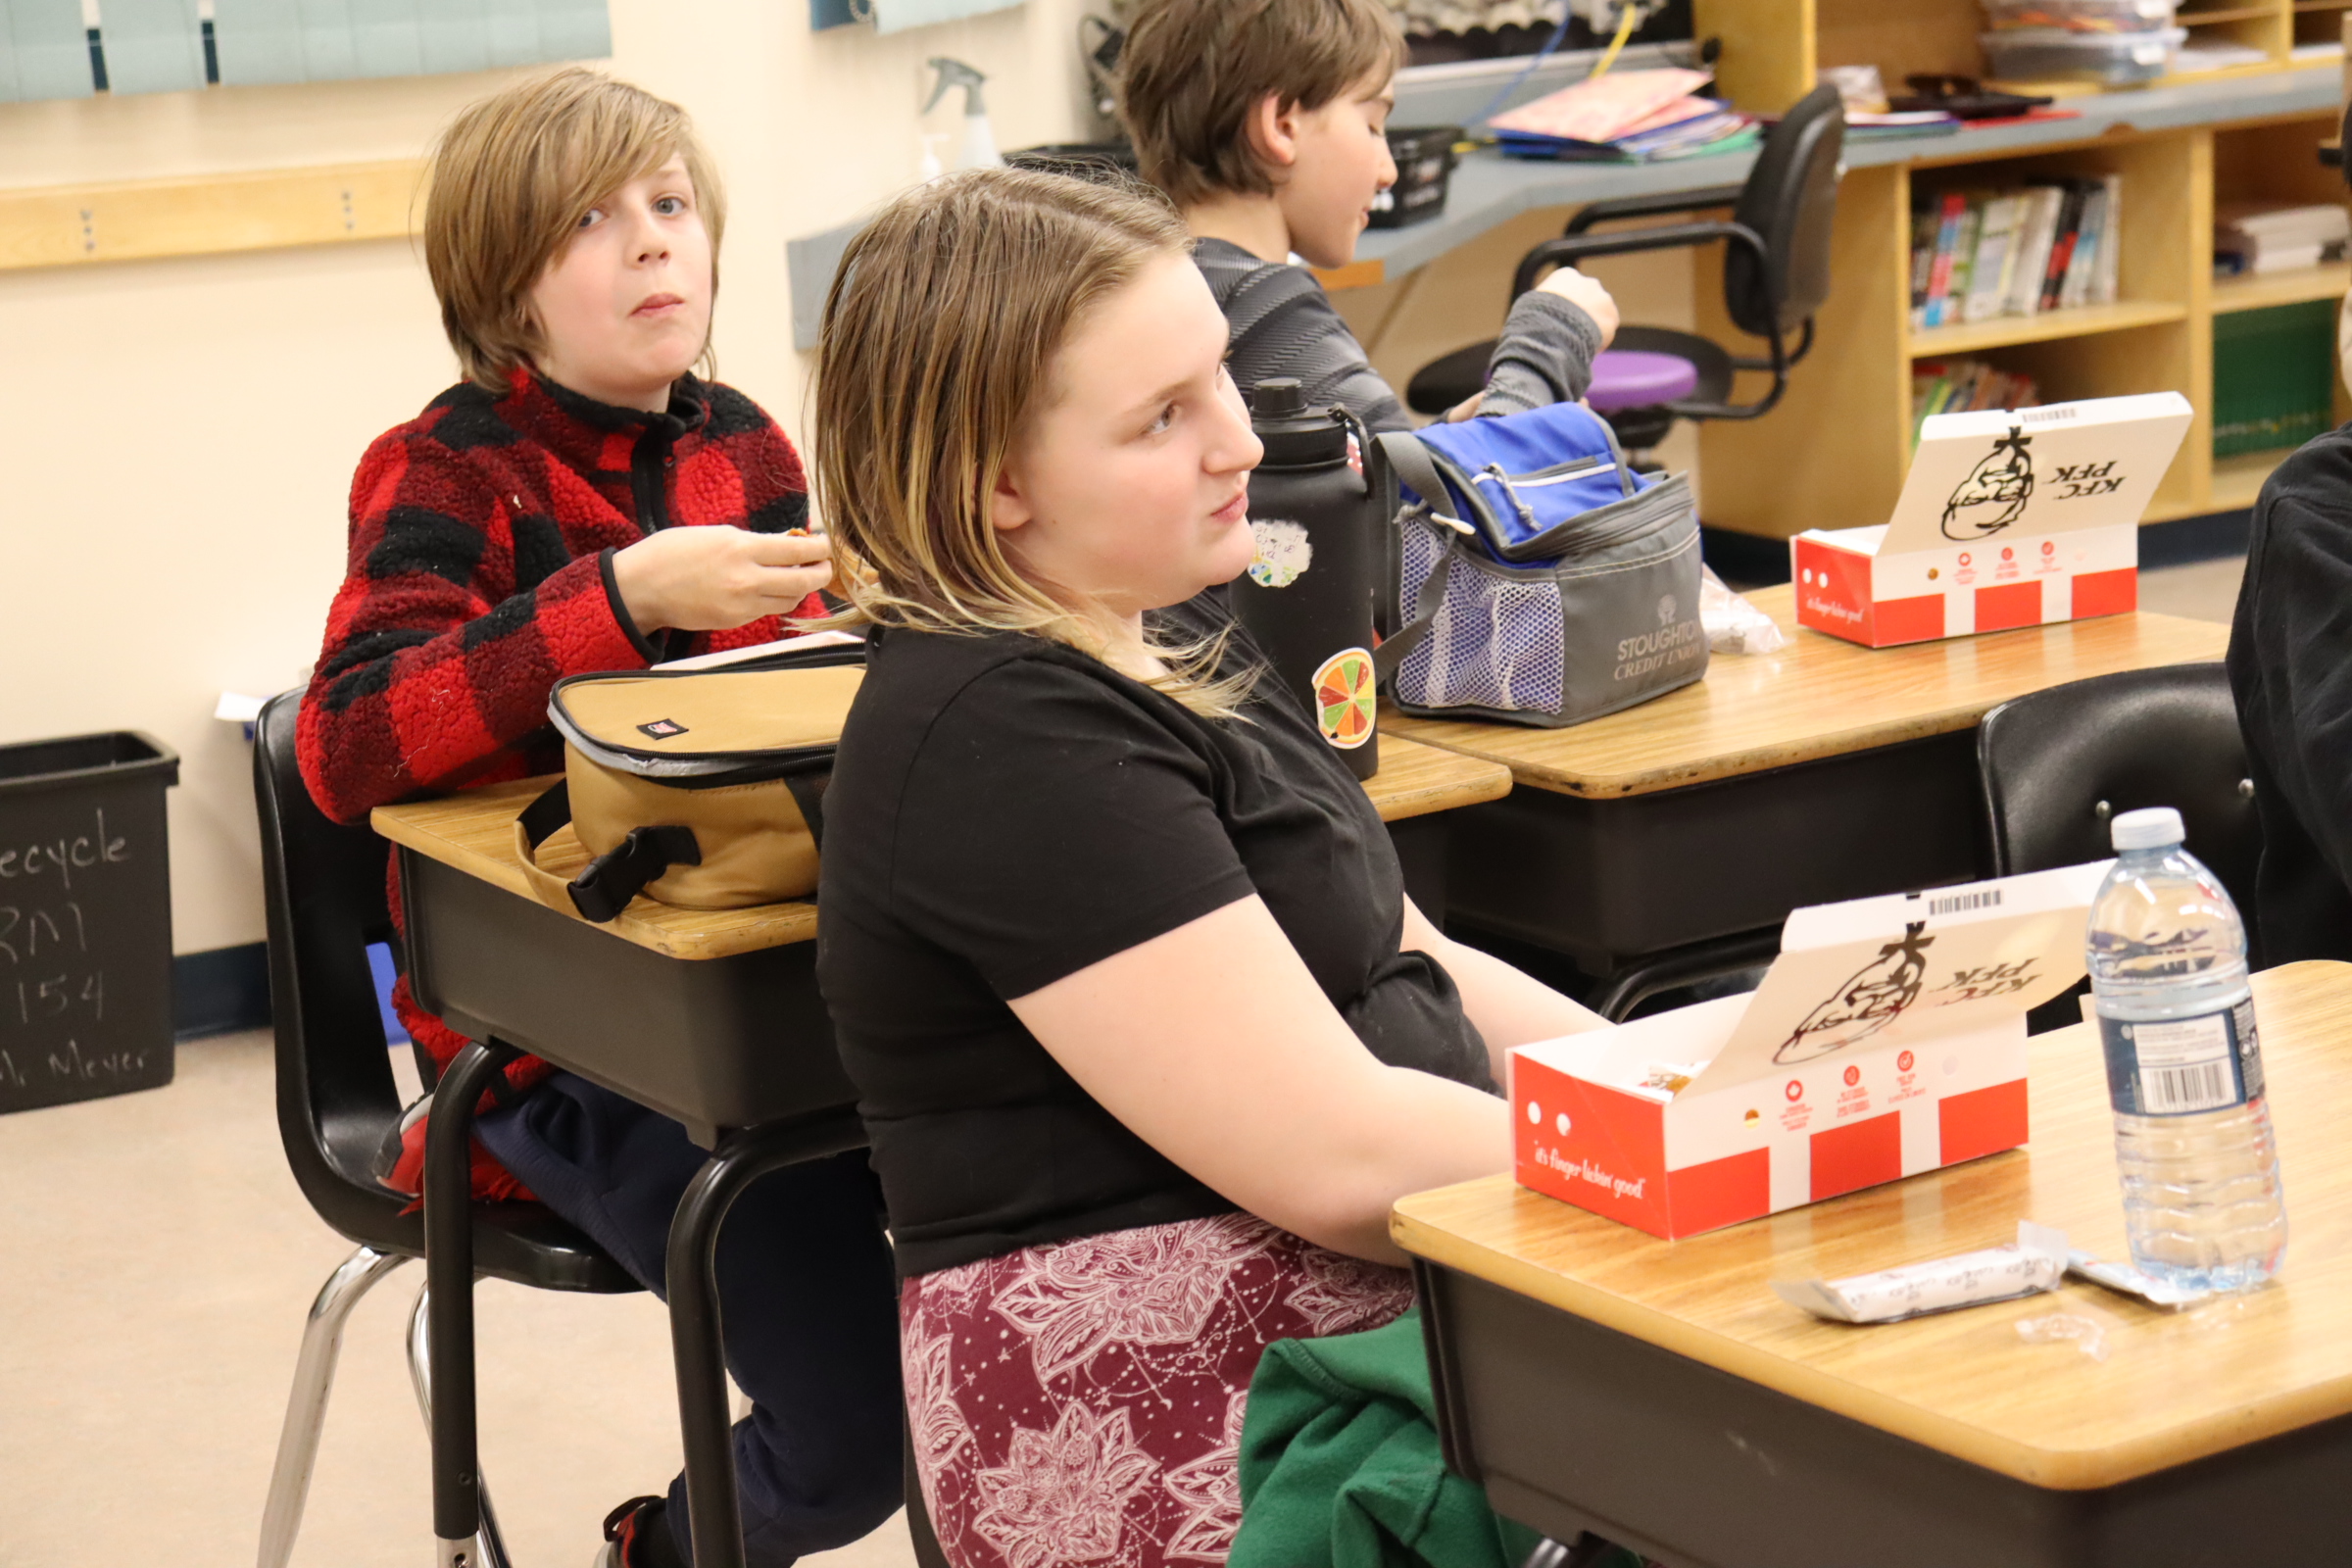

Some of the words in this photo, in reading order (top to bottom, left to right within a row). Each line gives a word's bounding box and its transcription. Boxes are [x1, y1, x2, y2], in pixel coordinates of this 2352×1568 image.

[2042, 460, 2118, 484] PFK
[2053, 476, 2126, 500] KFC
[1614, 653, 1667, 680] CREDIT
[18, 969, 103, 1024] 154
